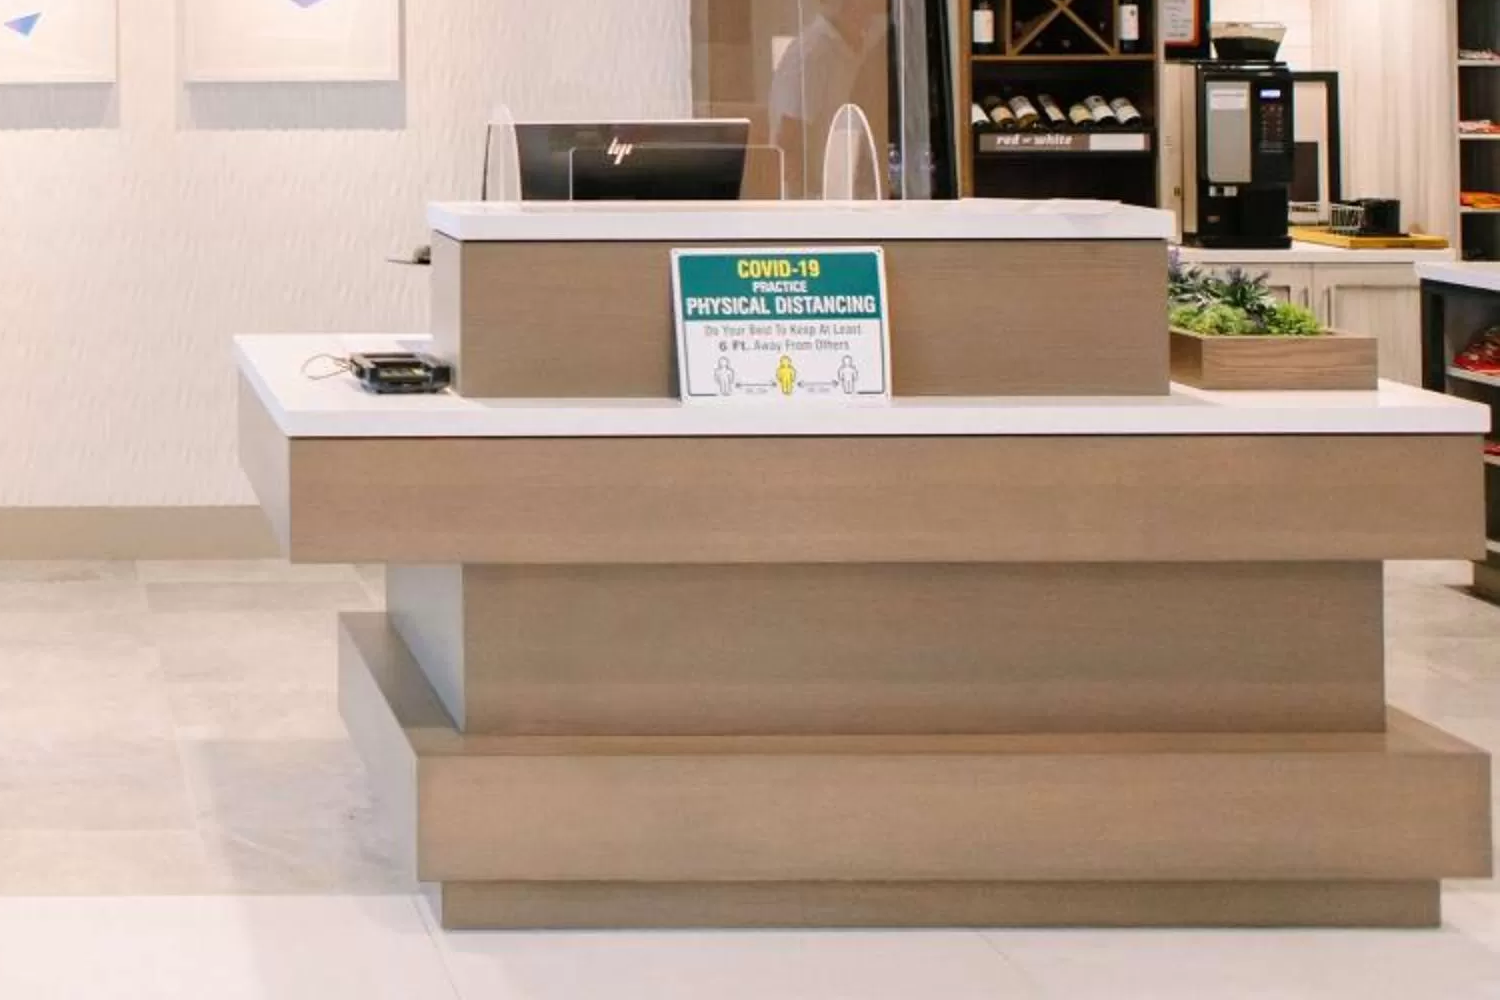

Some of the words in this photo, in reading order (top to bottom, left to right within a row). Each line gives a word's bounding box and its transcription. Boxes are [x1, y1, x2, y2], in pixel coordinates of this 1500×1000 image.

[996, 133, 1020, 145] red
[1034, 133, 1072, 145] white
[737, 259, 820, 278] COVID-19
[752, 280, 808, 293] PRACTICE
[686, 297, 770, 316] PHYSICAL
[775, 294, 875, 313] DISTANCING
[790, 324, 816, 336] Keep
[719, 341, 728, 352] 6
[753, 340, 781, 352] Away
[785, 339, 812, 350] From
[815, 339, 849, 350] Others
